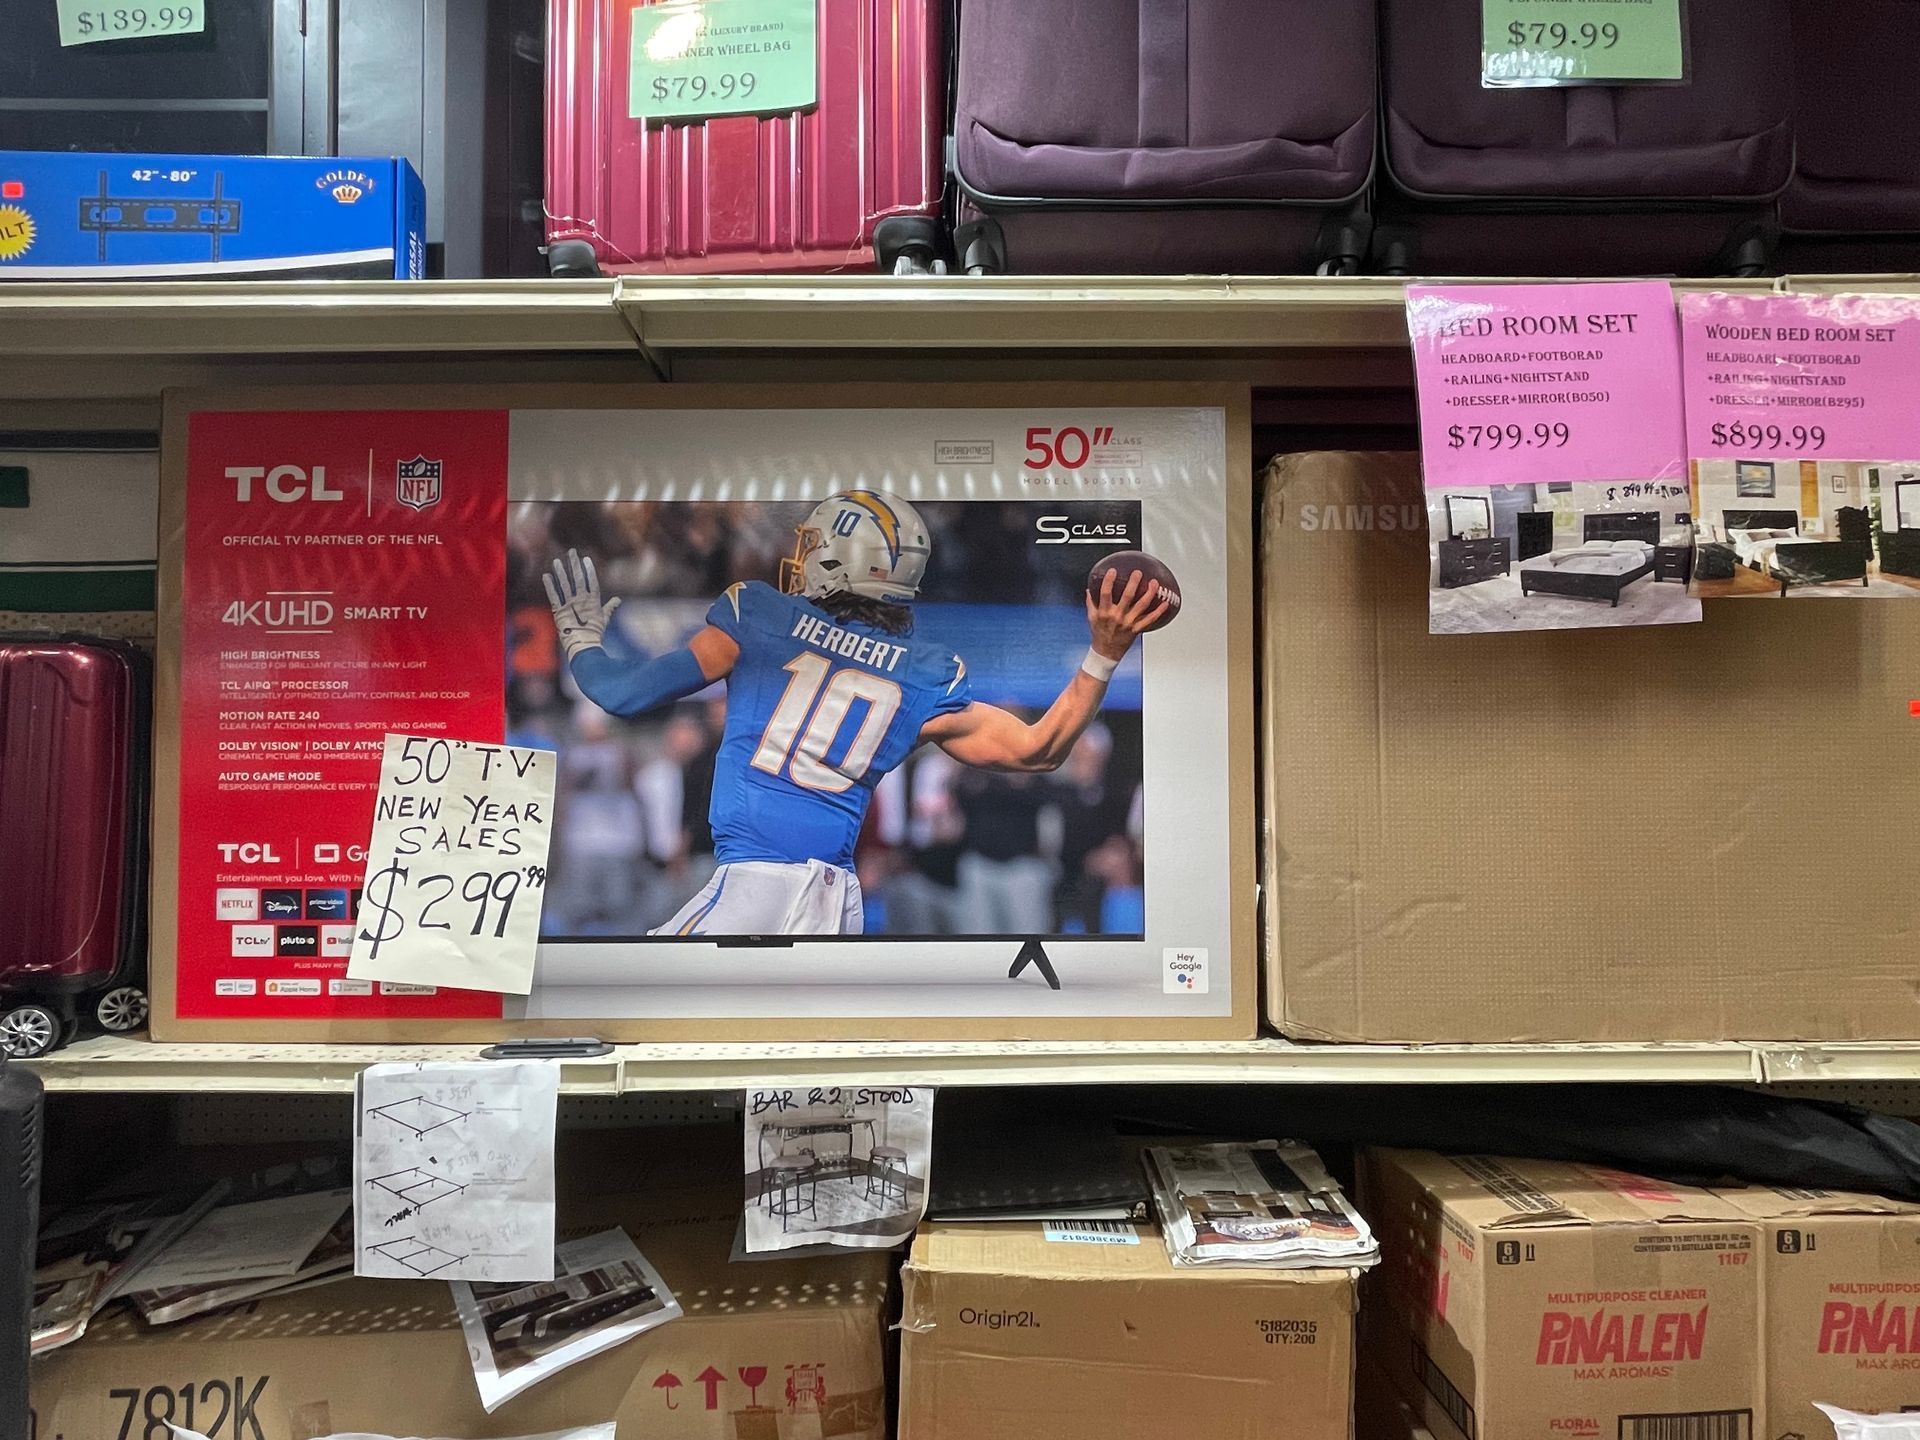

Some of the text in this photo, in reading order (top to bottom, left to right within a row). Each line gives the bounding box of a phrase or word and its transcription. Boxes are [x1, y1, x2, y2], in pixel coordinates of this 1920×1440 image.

[77, 5, 194, 35] $139.99
[1507, 20, 1619, 49] $79.99
[718, 40, 791, 56] WHEEL BAG
[651, 72, 756, 103] $79.99
[316, 170, 373, 190] GOLDEN
[1502, 315, 1577, 337] ROOM
[1587, 314, 1638, 334] SET
[1705, 325, 1896, 342] WOODEN BED ROOM SET
[1111, 437, 1142, 445] CLASS
[1448, 422, 1569, 450] $799.99
[1711, 420, 1825, 450] $899.99
[224, 464, 436, 503] TCL NFL
[831, 509, 862, 538] 10
[1300, 504, 1428, 531] SAMSU
[222, 534, 443, 546] OFFICIAL TV PARTNER OF THE NFL
[343, 606, 402, 620] SMART
[406, 606, 428, 619] TV
[792, 613, 907, 672] HERBERT
[221, 651, 320, 660] HIGH BRIGHTNESS
[289, 661, 331, 669] BRILLIANT
[334, 661, 368, 669] PICTURE
[371, 661, 379, 669] IN
[382, 661, 400, 669] ANY
[403, 661, 427, 669] LIGHT
[221, 681, 349, 690] TCL PROCESSOR
[284, 692, 329, 700] OPTIMIZED
[419, 691, 438, 699] AND
[440, 691, 470, 699] COLOR
[220, 711, 320, 720] MOTION RATE 240
[750, 650, 903, 794] 10
[250, 722, 272, 730] FAST
[274, 722, 306, 730] ACTION
[307, 722, 317, 730] IN
[391, 722, 410, 730] AND
[412, 722, 447, 730] GAMING
[219, 741, 257, 751] DOLBY
[312, 741, 350, 750] DOLBY
[218, 752, 264, 760] CINEMATIC
[265, 752, 301, 760] PICTURE
[303, 752, 321, 760] AND
[324, 752, 370, 760] IMMERSIVE
[218, 772, 321, 781] AUTO GAME MODE
[218, 783, 271, 791] RESPONSIVE
[272, 783, 337, 791] PERFORMANCE
[338, 783, 366, 791] EVERY
[377, 795, 543, 824] NEW YEAR
[395, 826, 521, 855] SALES
[217, 842, 281, 864] TCL
[216, 874, 282, 883] Entertainment
[285, 875, 302, 884] you
[304, 874, 326, 883] love.
[329, 874, 351, 883] With
[221, 900, 253, 909] NETFLIX
[1177, 953, 1194, 962] Hey
[1170, 962, 1202, 972] Google
[750, 1090, 799, 1115] BAR
[1718, 1253, 1748, 1265] 1167
[1548, 1289, 1707, 1304] MULTIPURPOSE CLEANER
[1856, 1358, 1887, 1369] MAX
[1574, 1368, 1605, 1380] MAX
[109, 1375, 270, 1440] 7812K
[1550, 1418, 1600, 1430] FLORAL
